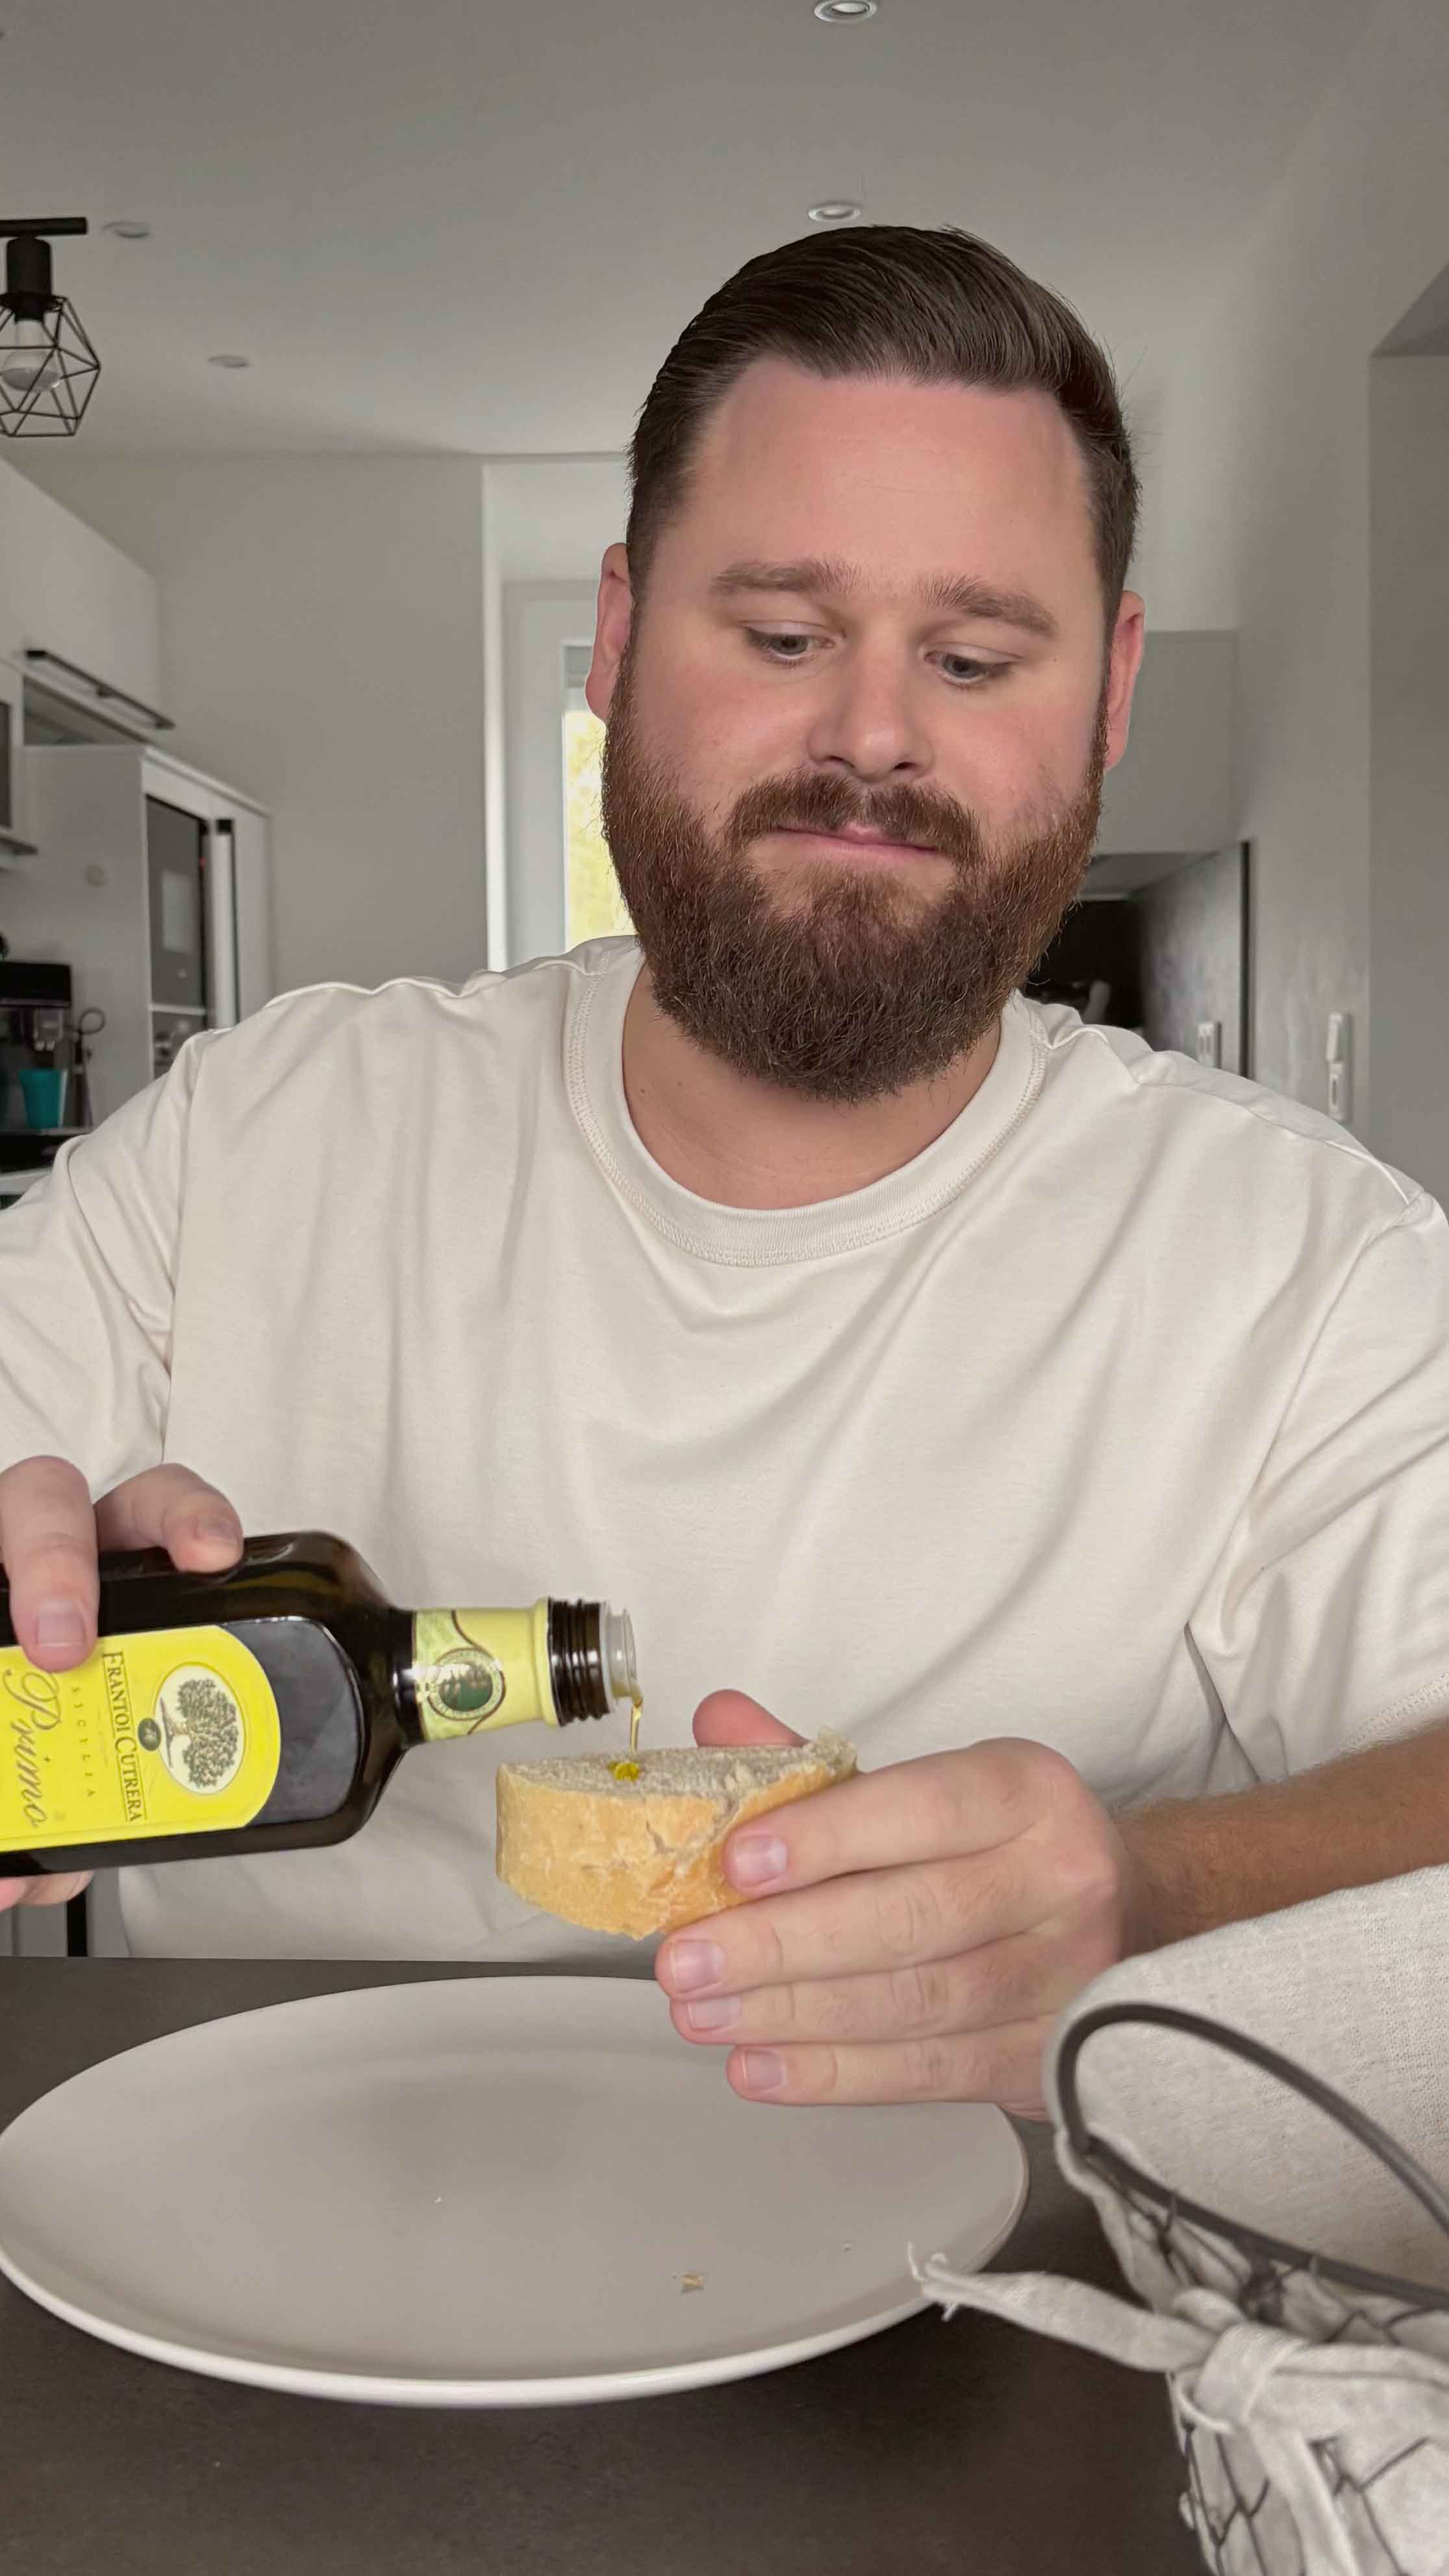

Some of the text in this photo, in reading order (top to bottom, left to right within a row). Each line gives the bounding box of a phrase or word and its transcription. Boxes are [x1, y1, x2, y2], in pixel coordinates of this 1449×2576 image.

[103, 1650, 131, 1733] FRANTOI
[3, 1669, 62, 1827] Primo
[72, 1686, 96, 1798] SICILIA
[115, 1736, 144, 1822] CUTRERA
